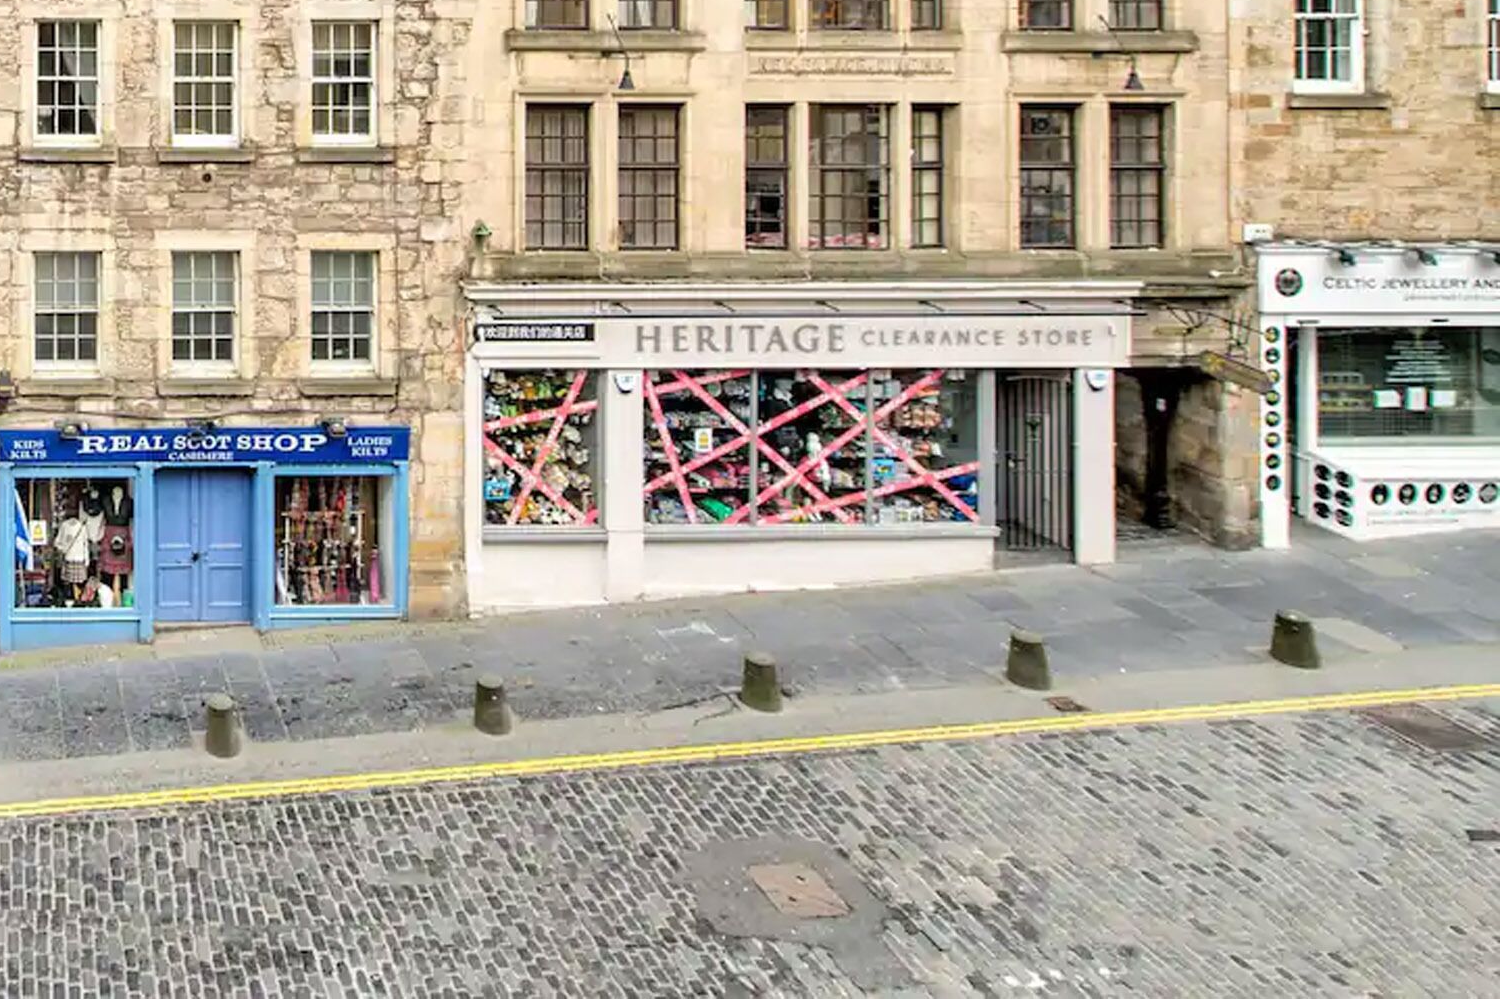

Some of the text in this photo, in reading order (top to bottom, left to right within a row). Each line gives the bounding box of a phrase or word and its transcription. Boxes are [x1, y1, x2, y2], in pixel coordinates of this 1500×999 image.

[1322, 276, 1500, 290] CELTIC JEWELLERY AND
[635, 324, 1093, 354] HERITAGE CLEARANCE STORE
[13, 439, 45, 450] KIDS
[77, 433, 328, 454] REAL SCOT SHOP
[347, 436, 393, 446] LADIES
[10, 450, 47, 460] KILTS
[168, 451, 234, 461] CASHMERE
[351, 446, 389, 457] KILTS
